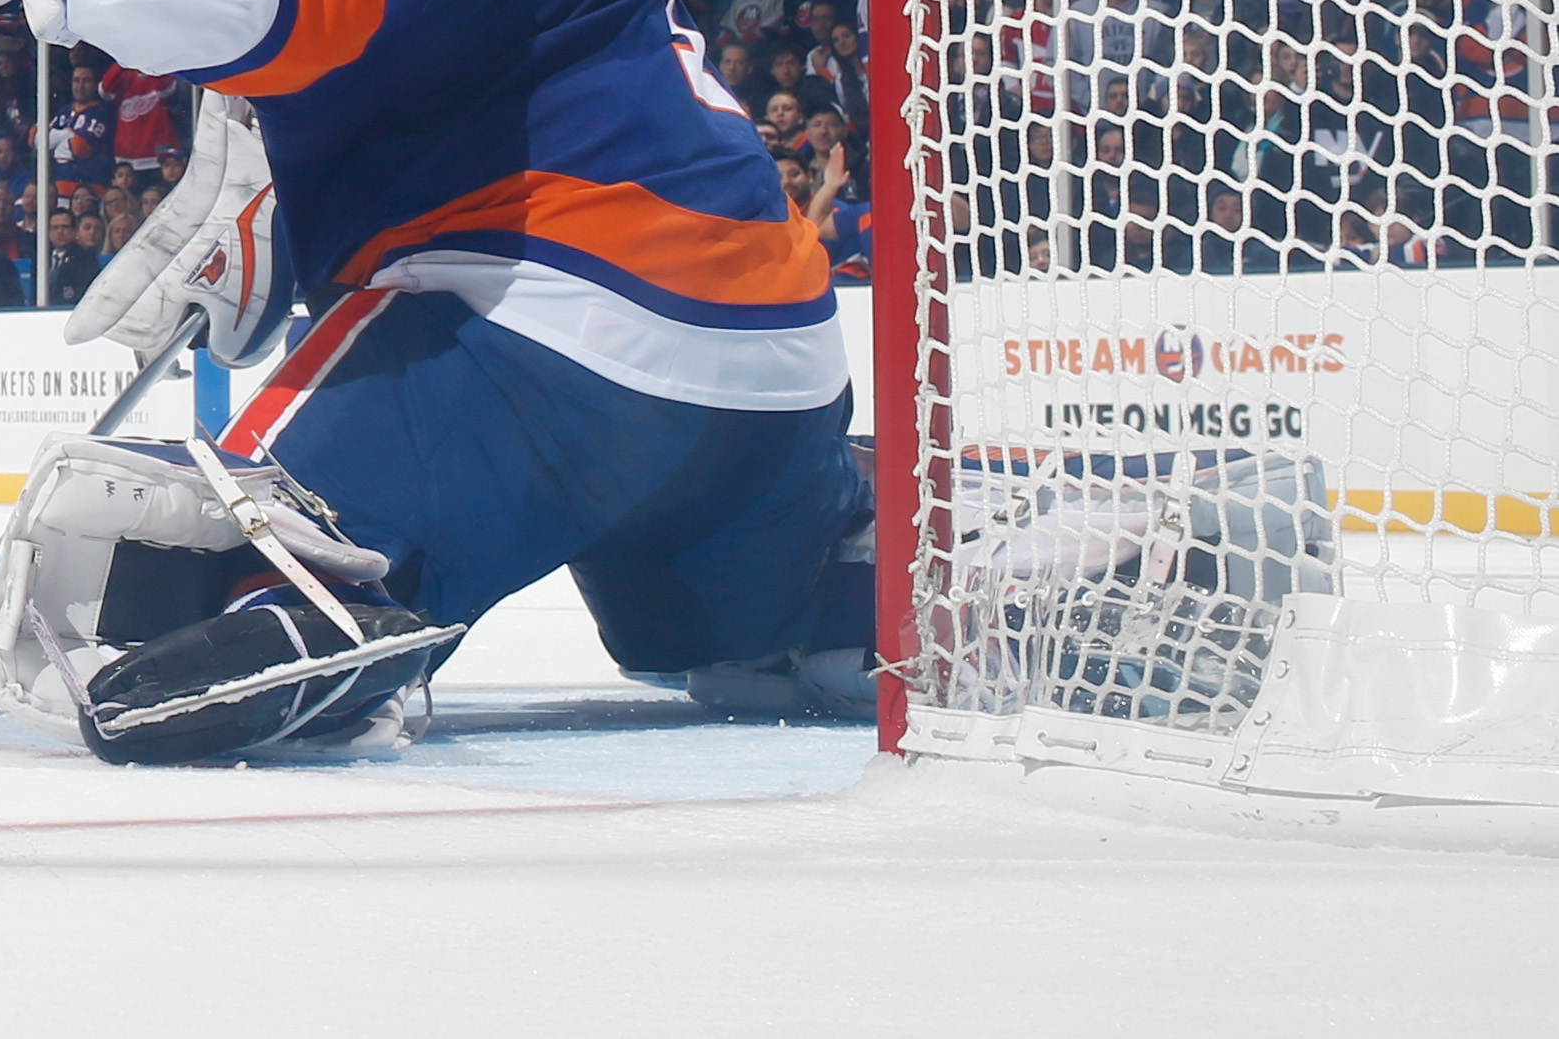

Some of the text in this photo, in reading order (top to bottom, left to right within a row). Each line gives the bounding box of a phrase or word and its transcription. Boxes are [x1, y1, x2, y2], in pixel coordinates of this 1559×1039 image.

[1004, 333, 1345, 375] STREAM GAMES
[43, 371, 62, 397] ON
[70, 371, 107, 397] SALE
[114, 371, 137, 397] NO
[1045, 403, 1113, 437] LIVE
[1123, 403, 1169, 436] ON
[1179, 403, 1252, 438] MSG
